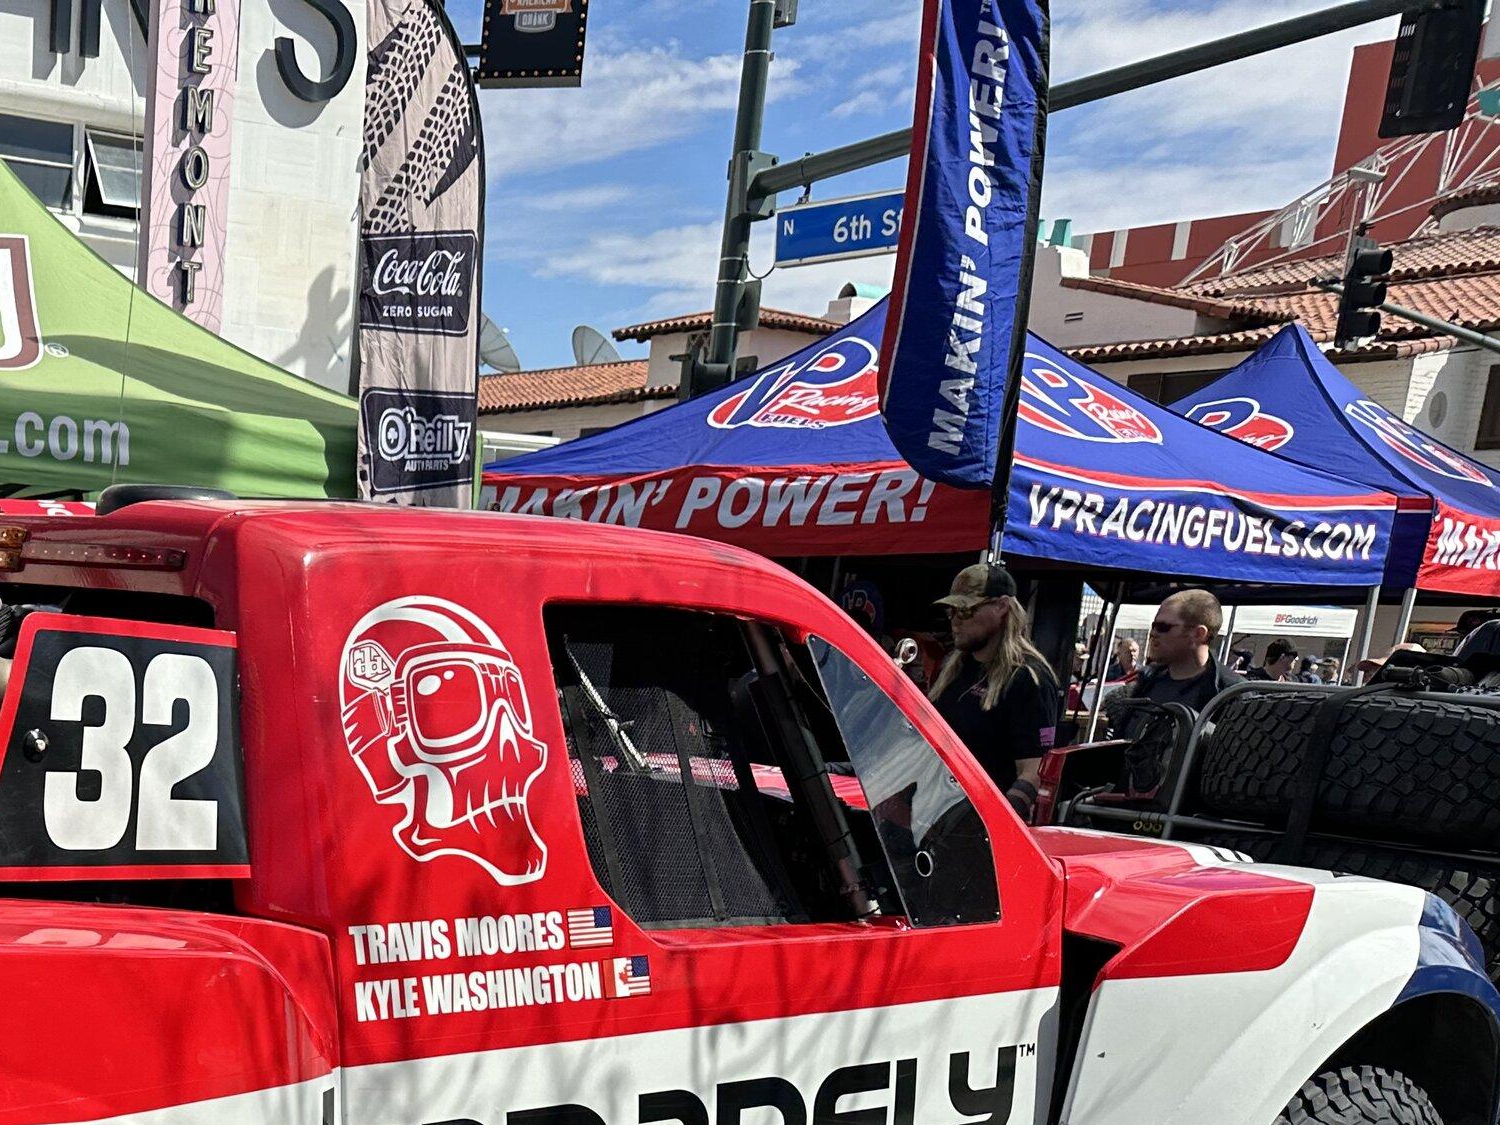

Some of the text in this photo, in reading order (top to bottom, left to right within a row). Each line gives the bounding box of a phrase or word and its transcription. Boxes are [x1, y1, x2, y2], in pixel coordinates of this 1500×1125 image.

[178, 0, 214, 304] EMONT
[964, 20, 1009, 246] POWER!
[783, 219, 794, 236] N
[833, 214, 871, 243] 6th
[373, 249, 465, 297] Coca-Cola
[382, 305, 453, 317] ZERO SUGAR
[927, 254, 988, 457] MAKIN'
[381, 408, 468, 460] O'Reilly
[675, 467, 937, 529] POWER!
[1027, 484, 1376, 561] VPRACINGFUELS.COM
[1431, 517, 1500, 571] MAK
[43, 646, 219, 851] 32
[349, 910, 565, 965] TRAVIS MOORES
[354, 962, 602, 1022] KYLE WASHINGTON
